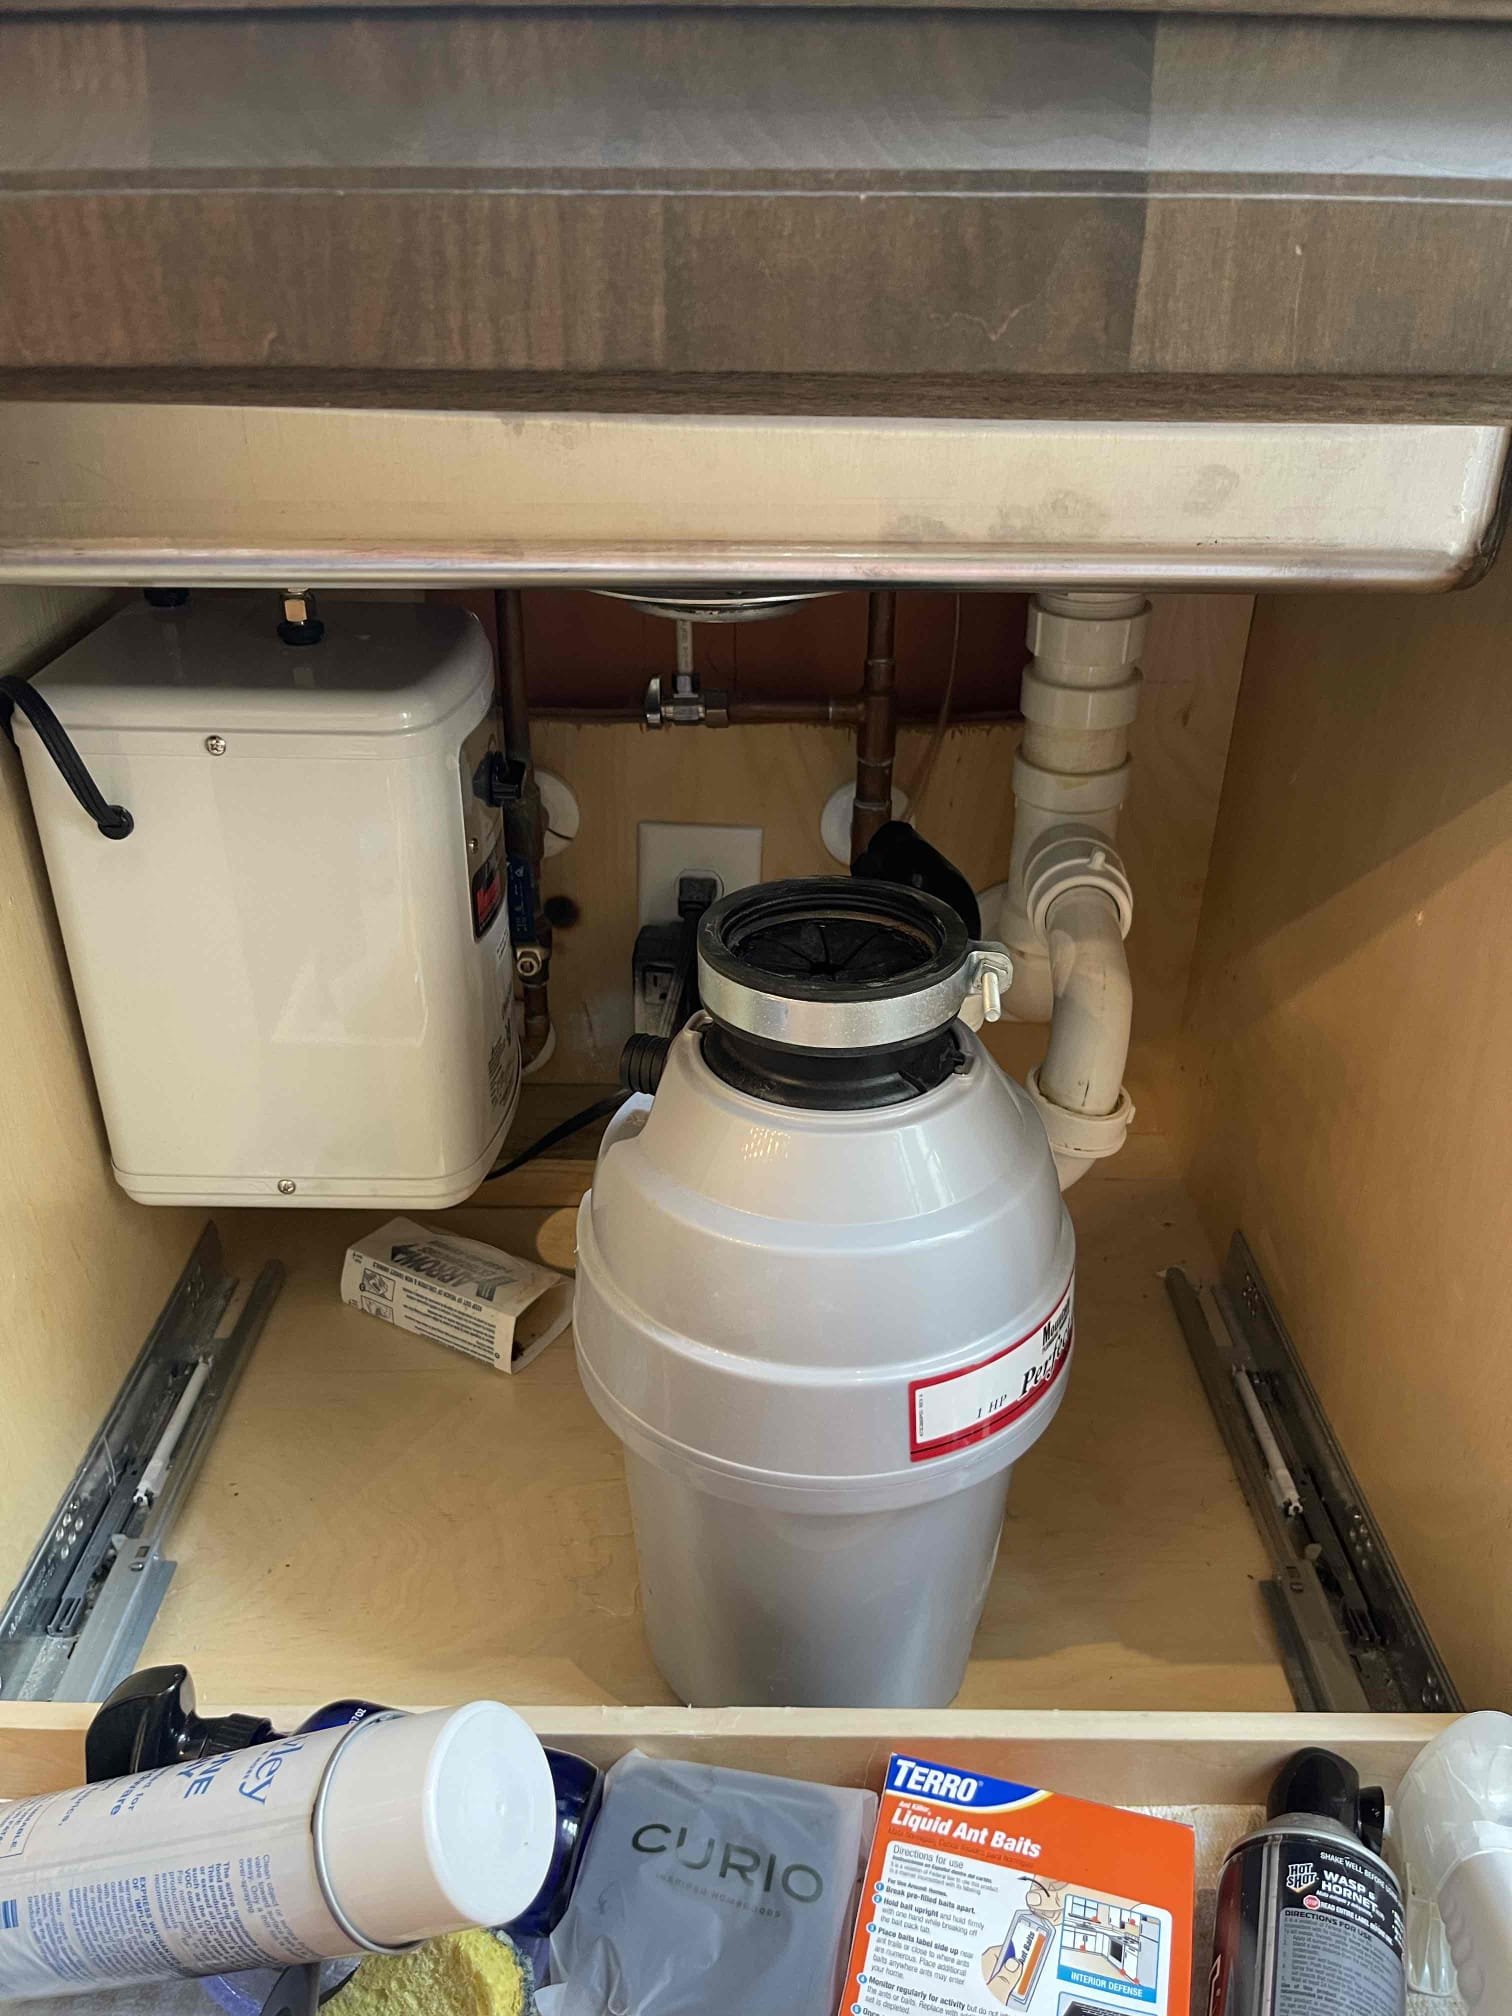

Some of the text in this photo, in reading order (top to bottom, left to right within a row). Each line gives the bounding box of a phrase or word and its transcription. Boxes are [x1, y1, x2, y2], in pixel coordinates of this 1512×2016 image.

[989, 1394, 1008, 1413] HP
[893, 1758, 978, 1802] TERRO
[892, 1808, 952, 1835] Liquid
[953, 1823, 988, 1844] Ant
[991, 1830, 1042, 1858] Baits
[200, 1866, 205, 1875] or
[631, 1823, 823, 1903] CURIO
[893, 1845, 963, 1869] Directions for use
[1289, 1863, 1313, 1875] HOT
[1320, 1852, 1344, 1865] SHAKE
[1344, 1858, 1363, 1874] WELL
[168, 1872, 181, 1916] production
[201, 1879, 213, 1908] exceed
[215, 1863, 232, 1920] food and drug
[226, 1882, 235, 1907] active
[1286, 1874, 1317, 1889] SHOT
[1323, 1870, 1367, 1894] WASP
[132, 1878, 150, 1934] OF IMPLIED
[140, 1877, 152, 1919] EXPRESS
[187, 1891, 199, 1921] content
[192, 1868, 215, 1936] such as the OTC
[209, 1885, 223, 1915] product
[219, 1916, 228, 1930] has
[886, 1886, 975, 1914] Break pre-filled baits apart.
[1321, 1880, 1378, 1912] HORNET
[884, 1898, 899, 1907] Hold
[900, 1902, 913, 1911] bait
[915, 1907, 938, 1917] upright
[953, 1915, 966, 1924] hold
[968, 1919, 984, 1931] firmly
[892, 1918, 902, 1926] bait
[909, 1914, 923, 1922] hand
[925, 1919, 940, 1927] while
[942, 1922, 968, 1936] breaking
[1284, 1909, 1373, 1940] DIRECTIONS FOR USE
[878, 1927, 896, 1937] Place
[898, 1932, 914, 1942] baits
[916, 1937, 933, 1947] label
[934, 1943, 948, 1952] side
[950, 1948, 958, 1956] up
[888, 1940, 902, 1949] trails
[911, 1947, 927, 1956] close
[937, 1954, 955, 1963] where
[1021, 1930, 1036, 1950] Baits
[871, 1965, 884, 1973] your
[873, 1954, 887, 1964] baits
[889, 1960, 918, 1973] anywhere
[919, 1969, 932, 1977] ants
[934, 1973, 947, 1982] may
[919, 1957, 936, 1968] Place
[937, 1964, 966, 1976] additional
[869, 1976, 894, 1990] Monitor
[896, 1986, 926, 2000] regularly
[929, 1993, 937, 2002] for
[940, 1998, 965, 2010] activity
[1071, 1972, 1143, 1997] INTERIOR DEFENSE
[867, 1986, 877, 1994] the
[878, 1991, 891, 1999] ants
[919, 2001, 943, 2014] Replace
